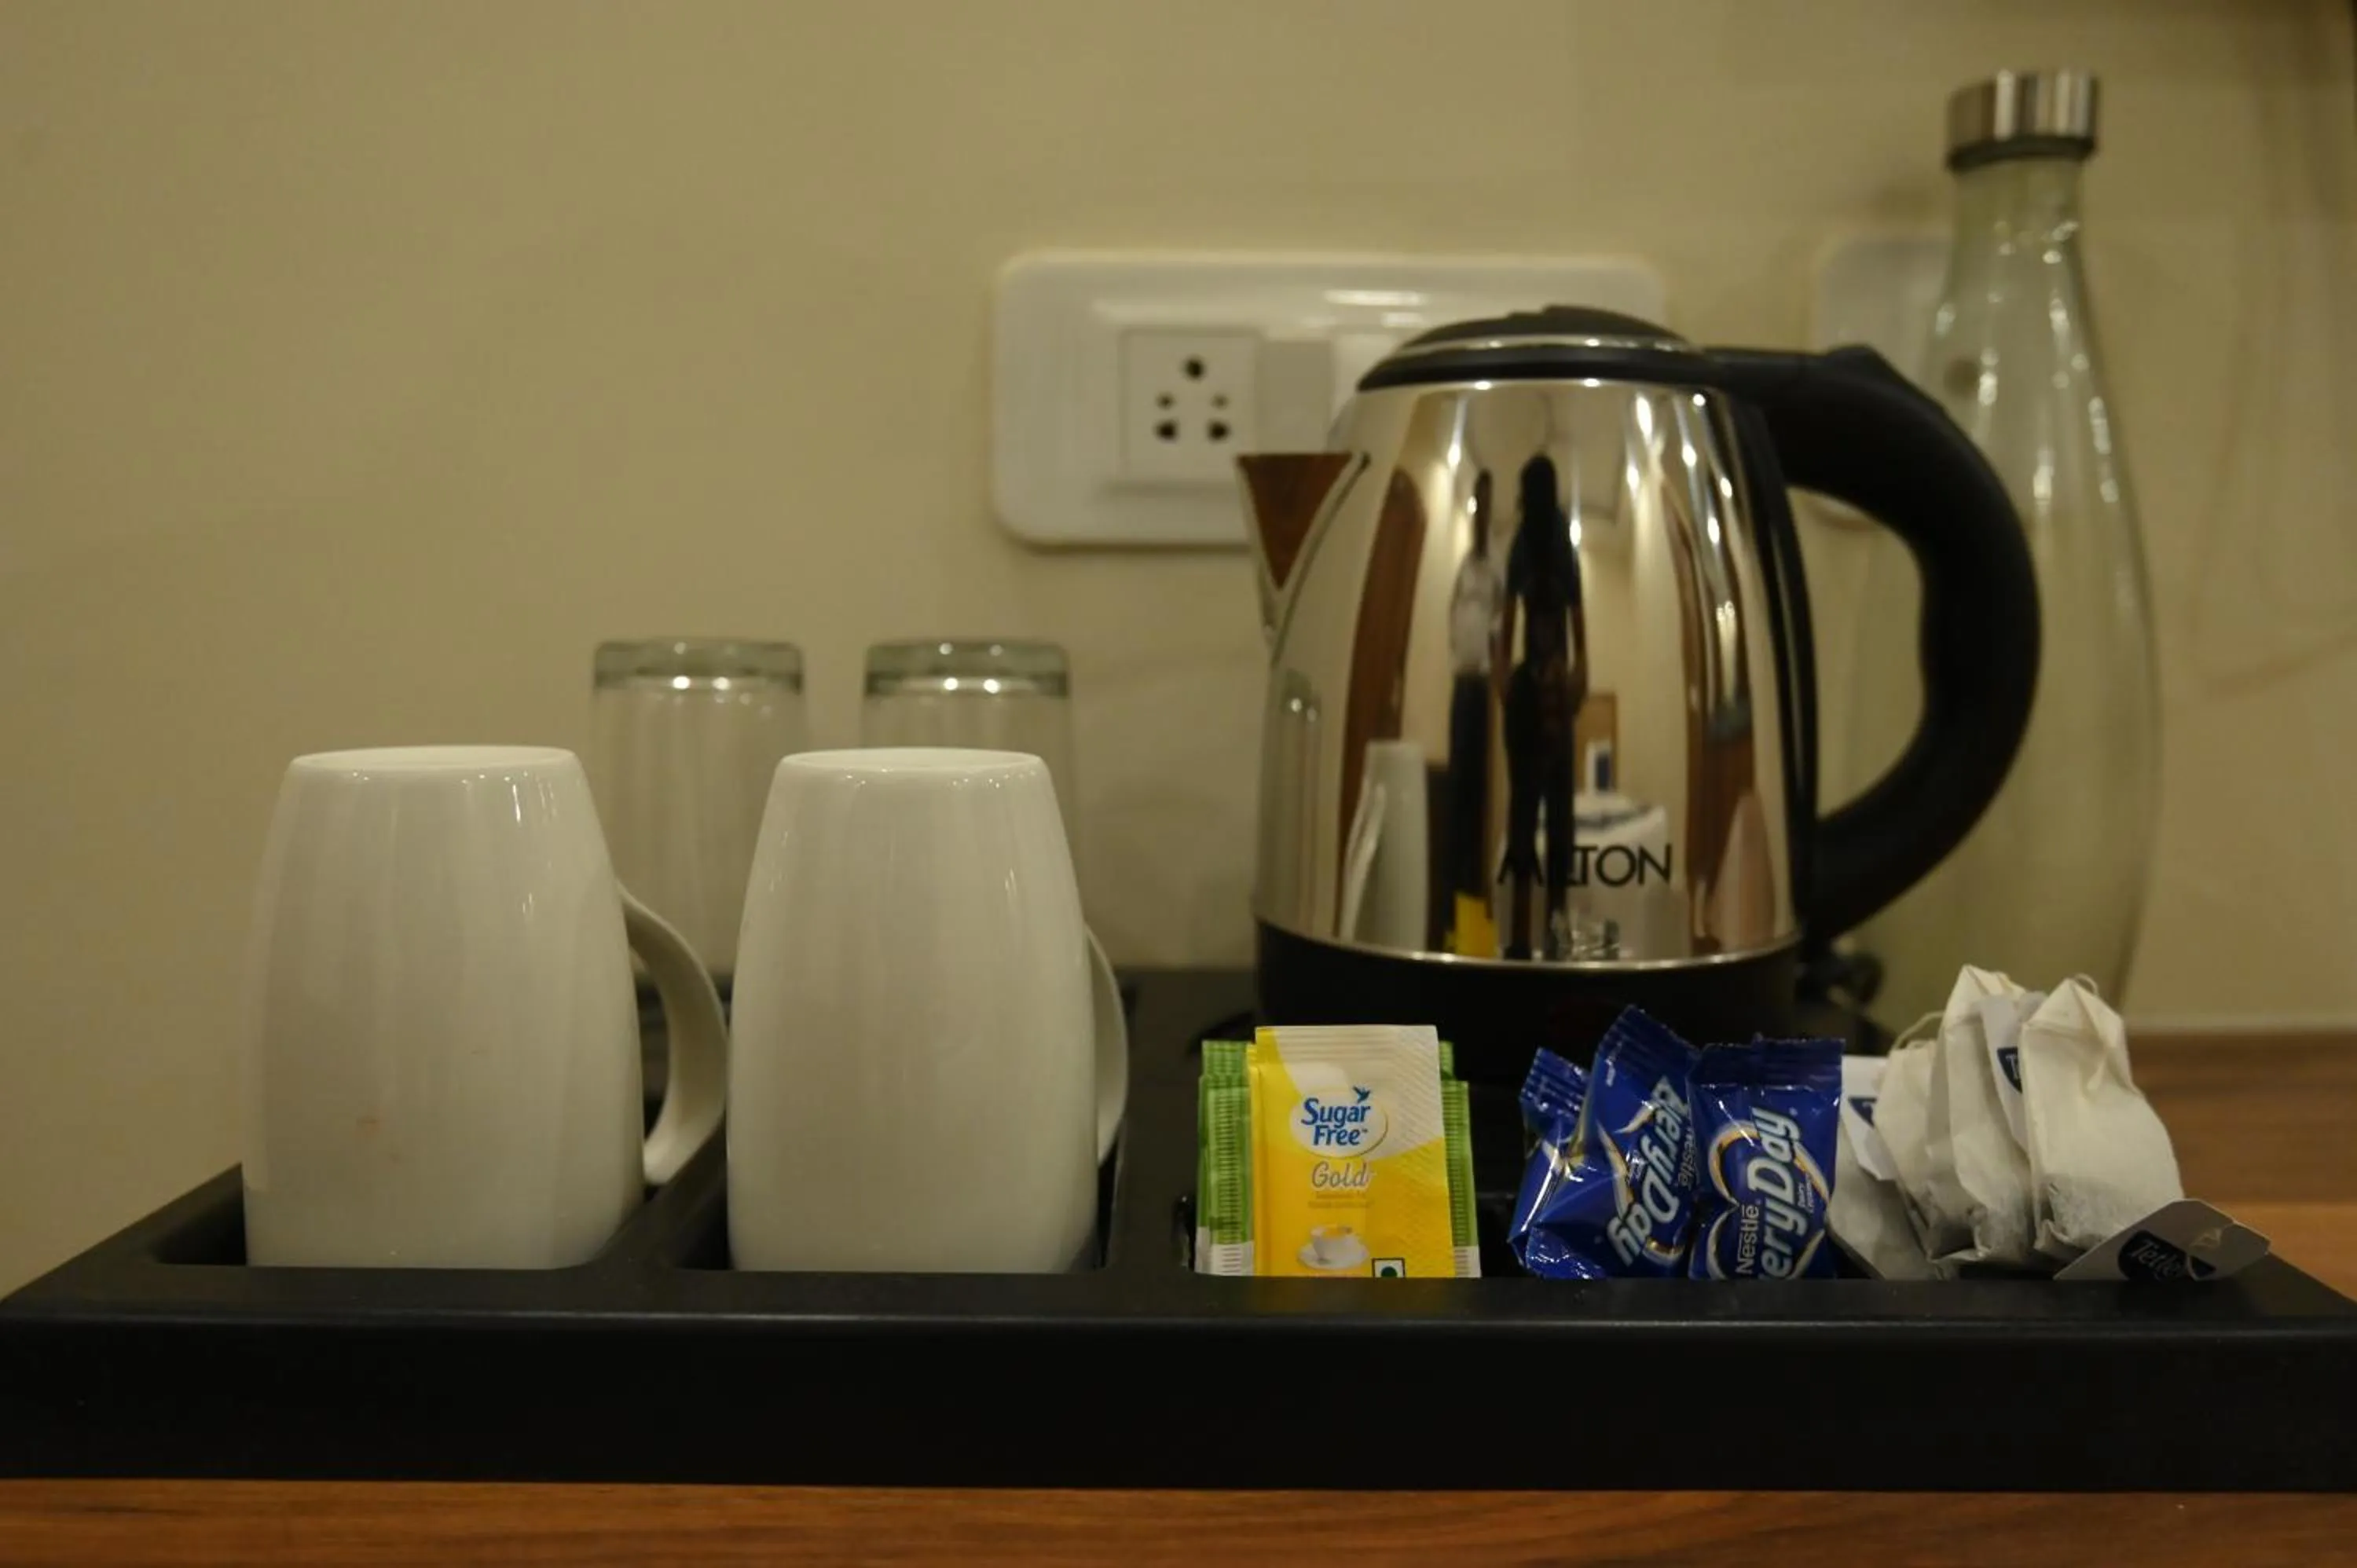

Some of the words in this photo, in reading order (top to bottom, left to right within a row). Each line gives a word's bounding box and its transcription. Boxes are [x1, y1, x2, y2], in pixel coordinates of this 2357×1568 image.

[1497, 843, 1672, 886] MTON
[1301, 1097, 1370, 1129] Sugar
[1311, 1160, 1369, 1189] Gold
[1747, 1106, 1808, 1279] eryDay
